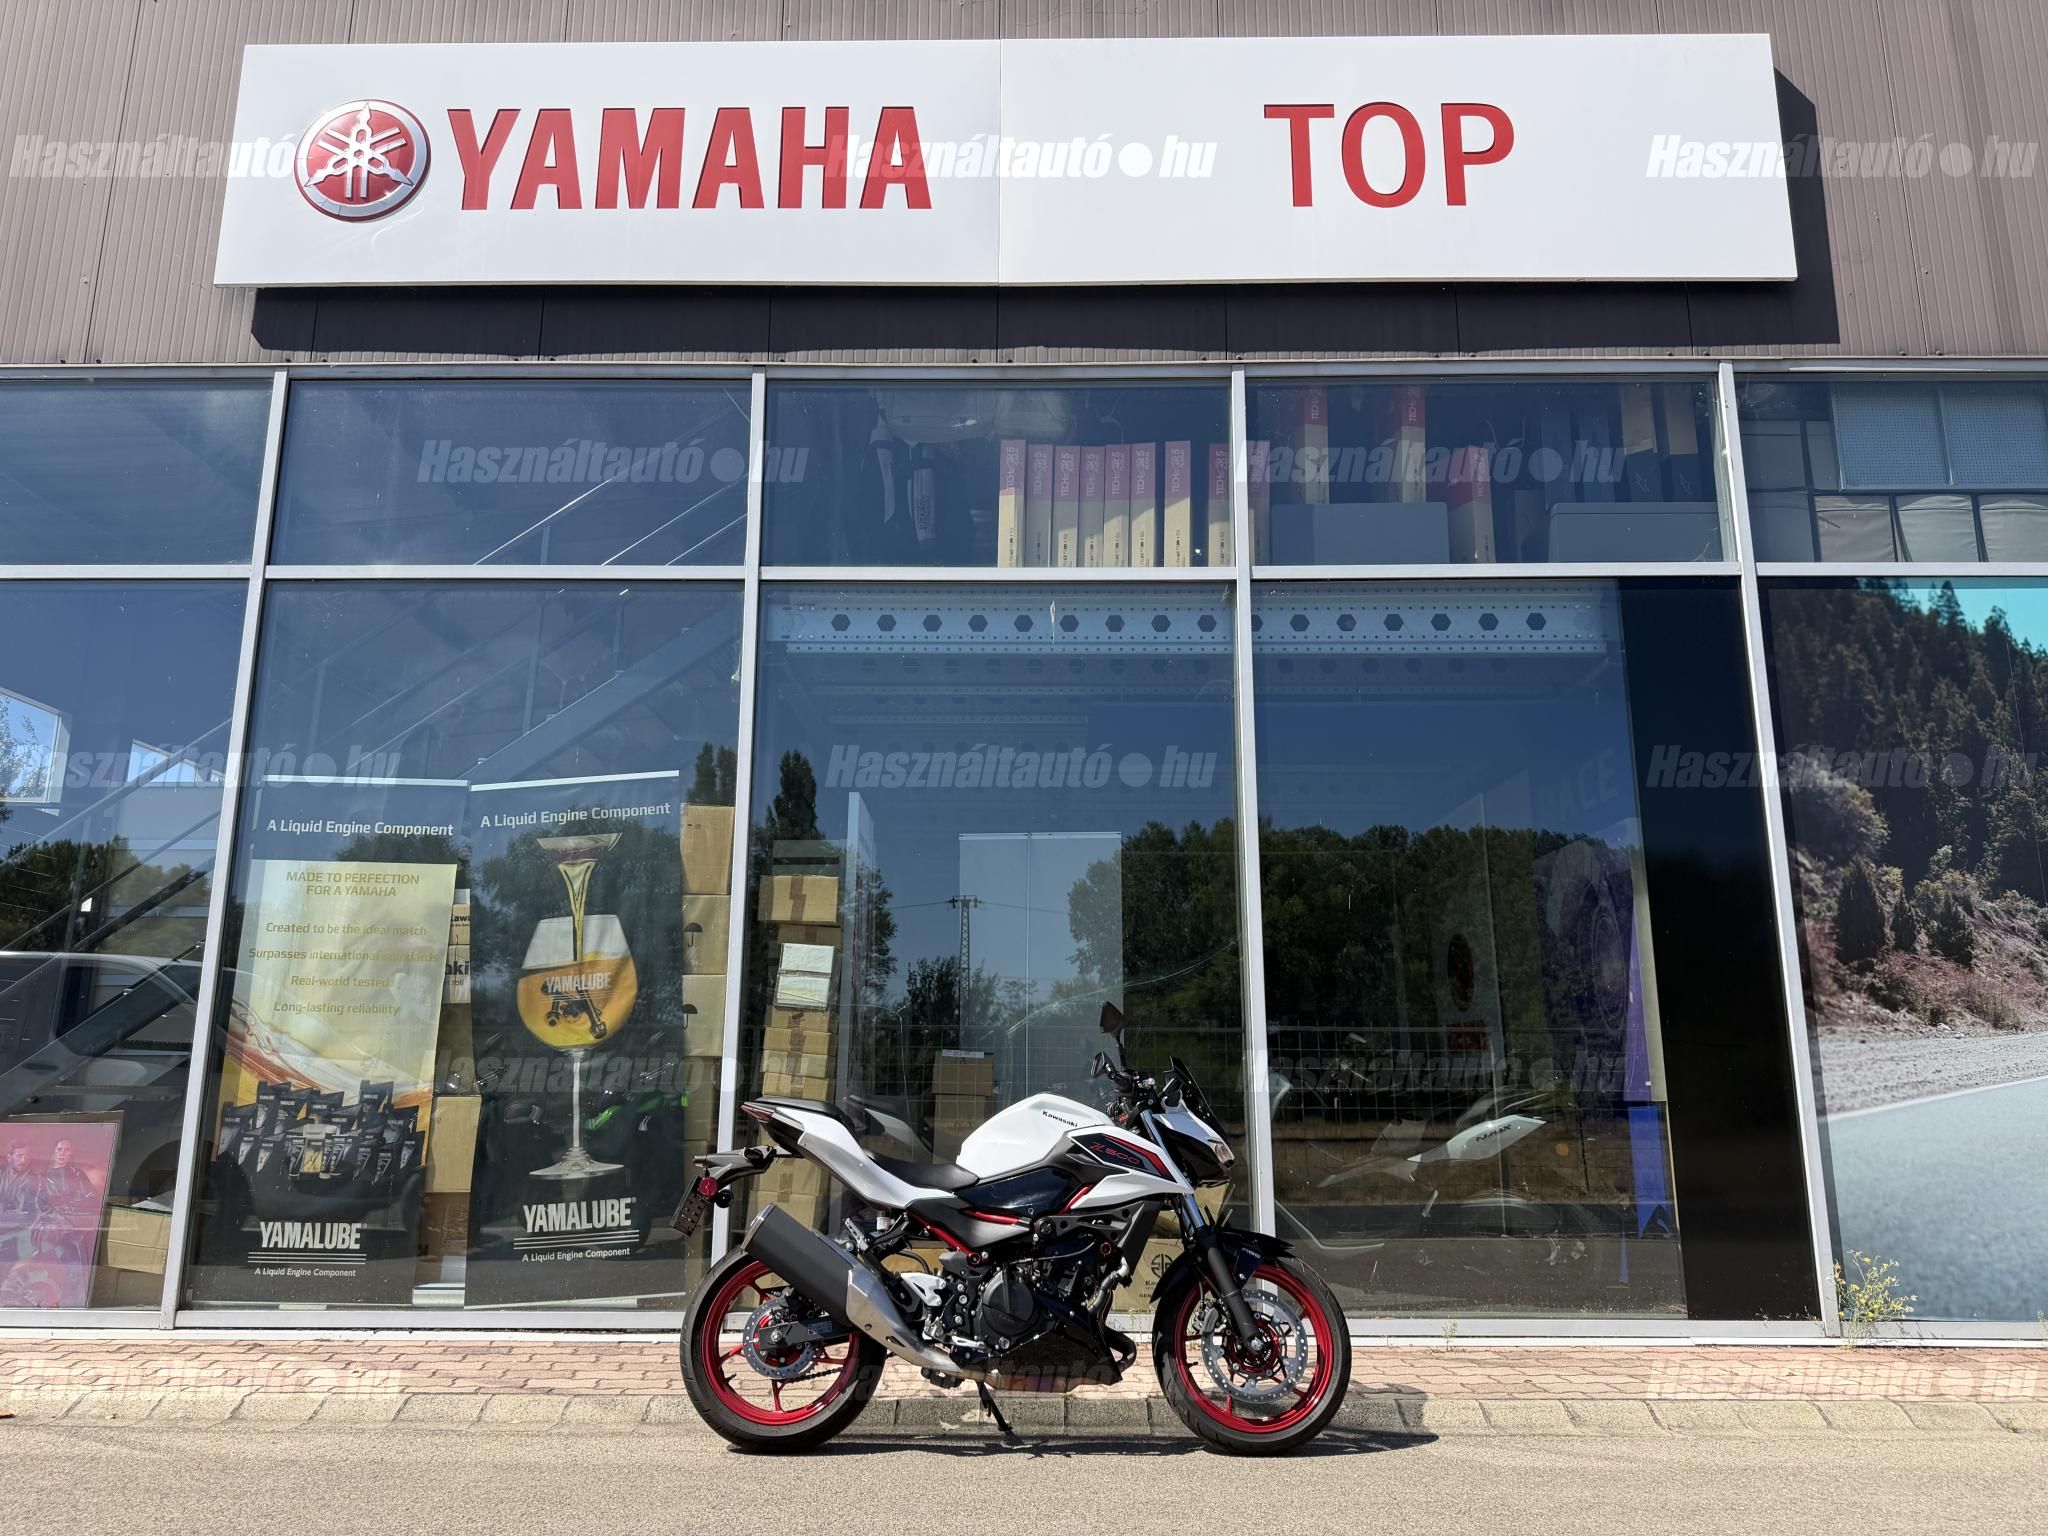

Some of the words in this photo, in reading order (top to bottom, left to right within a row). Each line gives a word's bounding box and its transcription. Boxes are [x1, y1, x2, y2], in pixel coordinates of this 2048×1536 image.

[446, 106, 933, 210] YAMAHA
[1263, 101, 1515, 209] TOP
[480, 815, 491, 828] A
[494, 812, 537, 829] Liquid
[540, 809, 588, 825] Engine
[591, 802, 671, 820] Component
[267, 819, 277, 832] A
[280, 819, 323, 835] Liquid
[325, 820, 371, 836] Engine
[374, 821, 454, 838] Component
[286, 871, 323, 883] MADE
[327, 872, 342, 883] TO
[344, 872, 420, 885] PERFECTION
[306, 884, 331, 895] FOR
[333, 885, 342, 896] A
[343, 885, 397, 897] YAMAHA
[266, 922, 310, 934] Created
[313, 923, 324, 934] to
[327, 922, 339, 934] be
[342, 923, 361, 935] the
[392, 924, 427, 936] match
[249, 949, 307, 961] Surpasses
[309, 949, 378, 961] international
[291, 975, 349, 987] Real-world
[352, 976, 389, 987] tested
[546, 972, 612, 993] YAMALUBE
[274, 1002, 344, 1015] Long-lasting
[347, 1002, 400, 1015] reliability
[1042, 1110, 1078, 1128] Kawasaki
[523, 1197, 632, 1233] YAMALUBE
[260, 1221, 361, 1250] YAMALUBE
[521, 1254, 529, 1262] A
[531, 1252, 555, 1263] Liquid
[557, 1251, 583, 1261] Engine
[585, 1247, 630, 1259] Component
[254, 1267, 261, 1275] A
[262, 1267, 285, 1277] Liquid
[287, 1268, 312, 1278] Engine
[313, 1268, 356, 1278] Component
